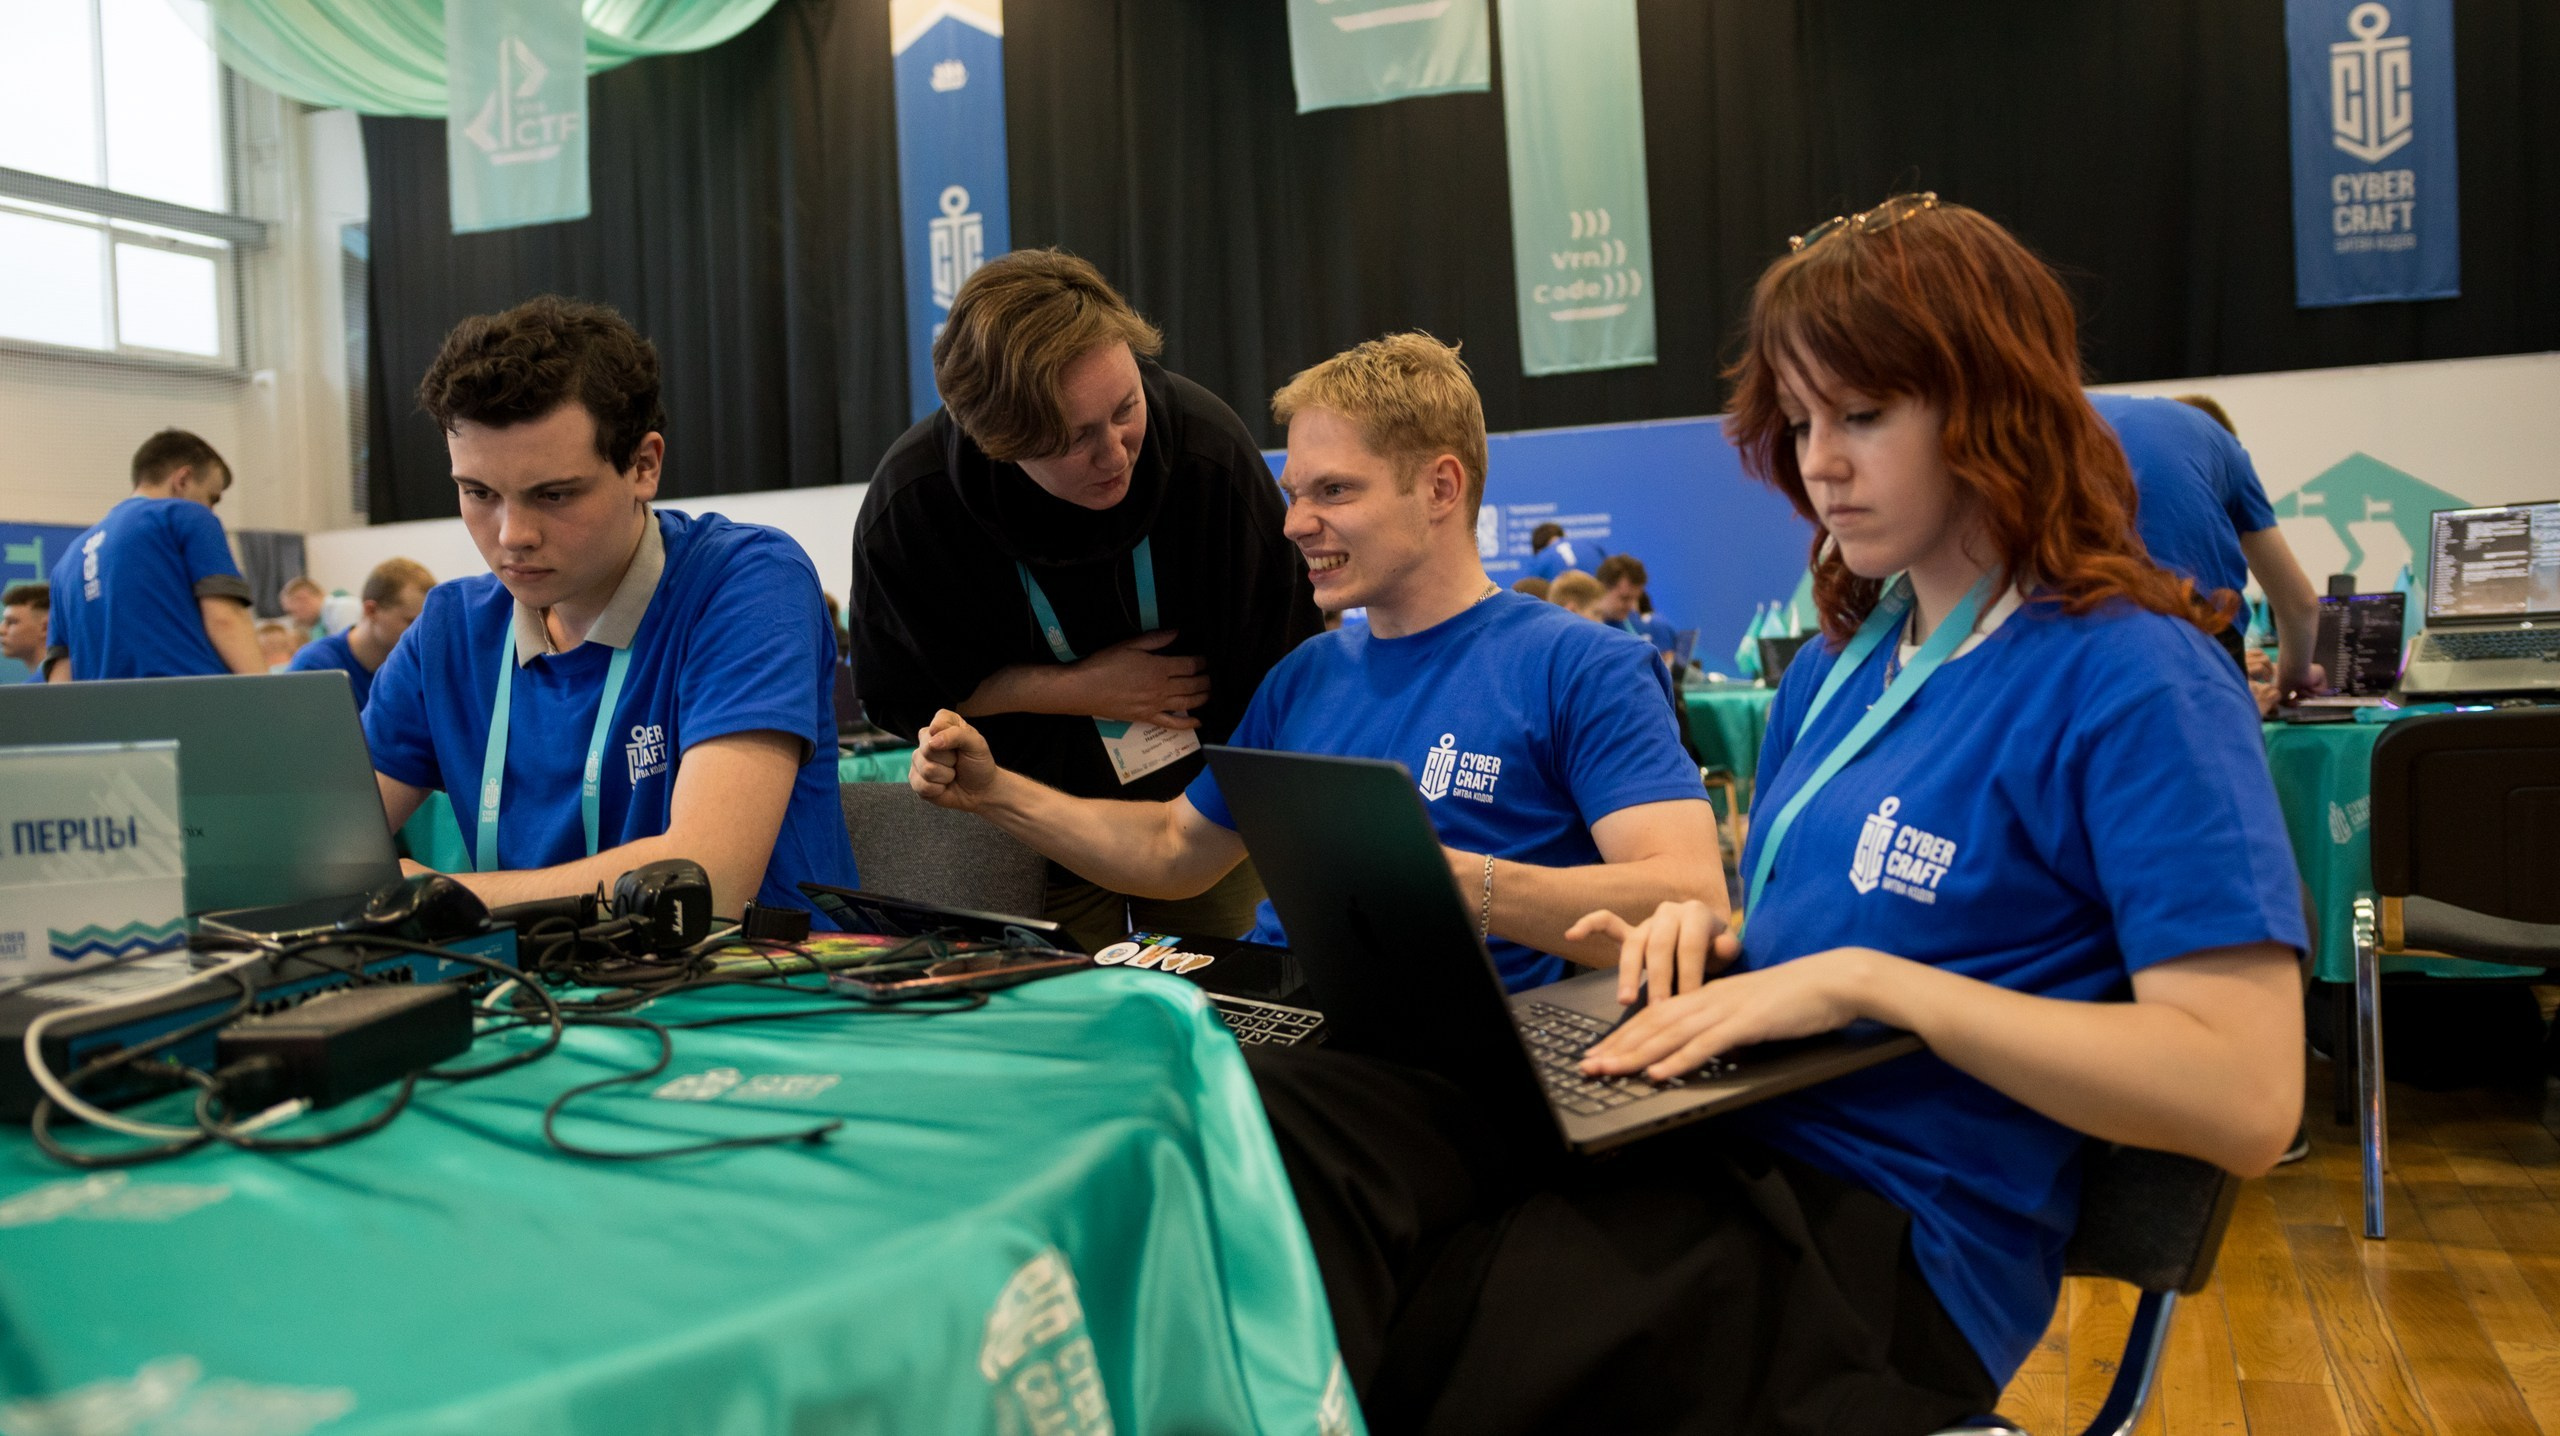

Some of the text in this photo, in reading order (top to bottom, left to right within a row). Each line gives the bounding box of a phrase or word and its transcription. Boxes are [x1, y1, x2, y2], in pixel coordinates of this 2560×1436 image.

[2331, 169, 2415, 205] CYBER
[2332, 201, 2415, 236] CRAFT
[1455, 768, 1499, 794] CRAFT
[1460, 751, 1502, 776] CYBER
[13, 815, 138, 855] ПЕРЦЫ
[1895, 825, 1957, 867] CYBER
[1885, 849, 1948, 889] CRAFT
